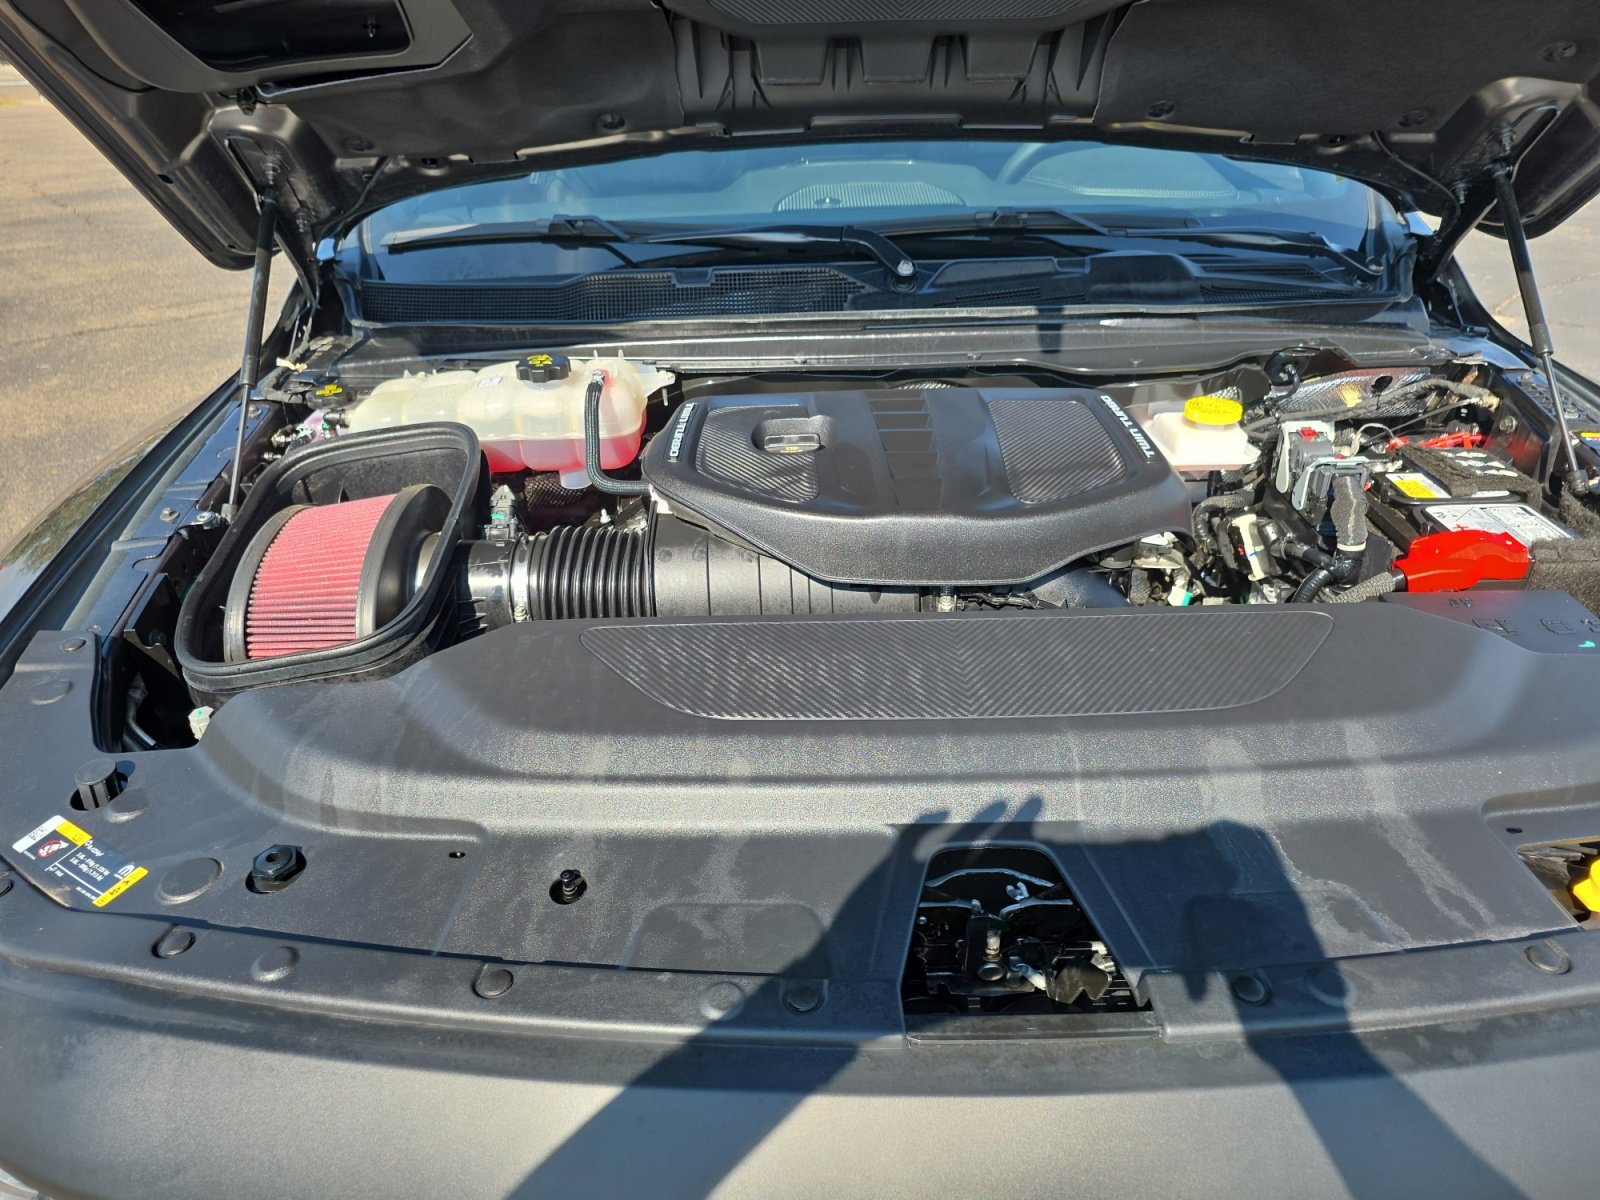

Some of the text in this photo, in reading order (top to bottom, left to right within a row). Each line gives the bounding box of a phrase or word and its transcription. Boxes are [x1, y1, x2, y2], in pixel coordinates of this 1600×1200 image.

[670, 402, 695, 457] TWIN TURBO
[1100, 395, 1155, 458] TWIN TURBO
